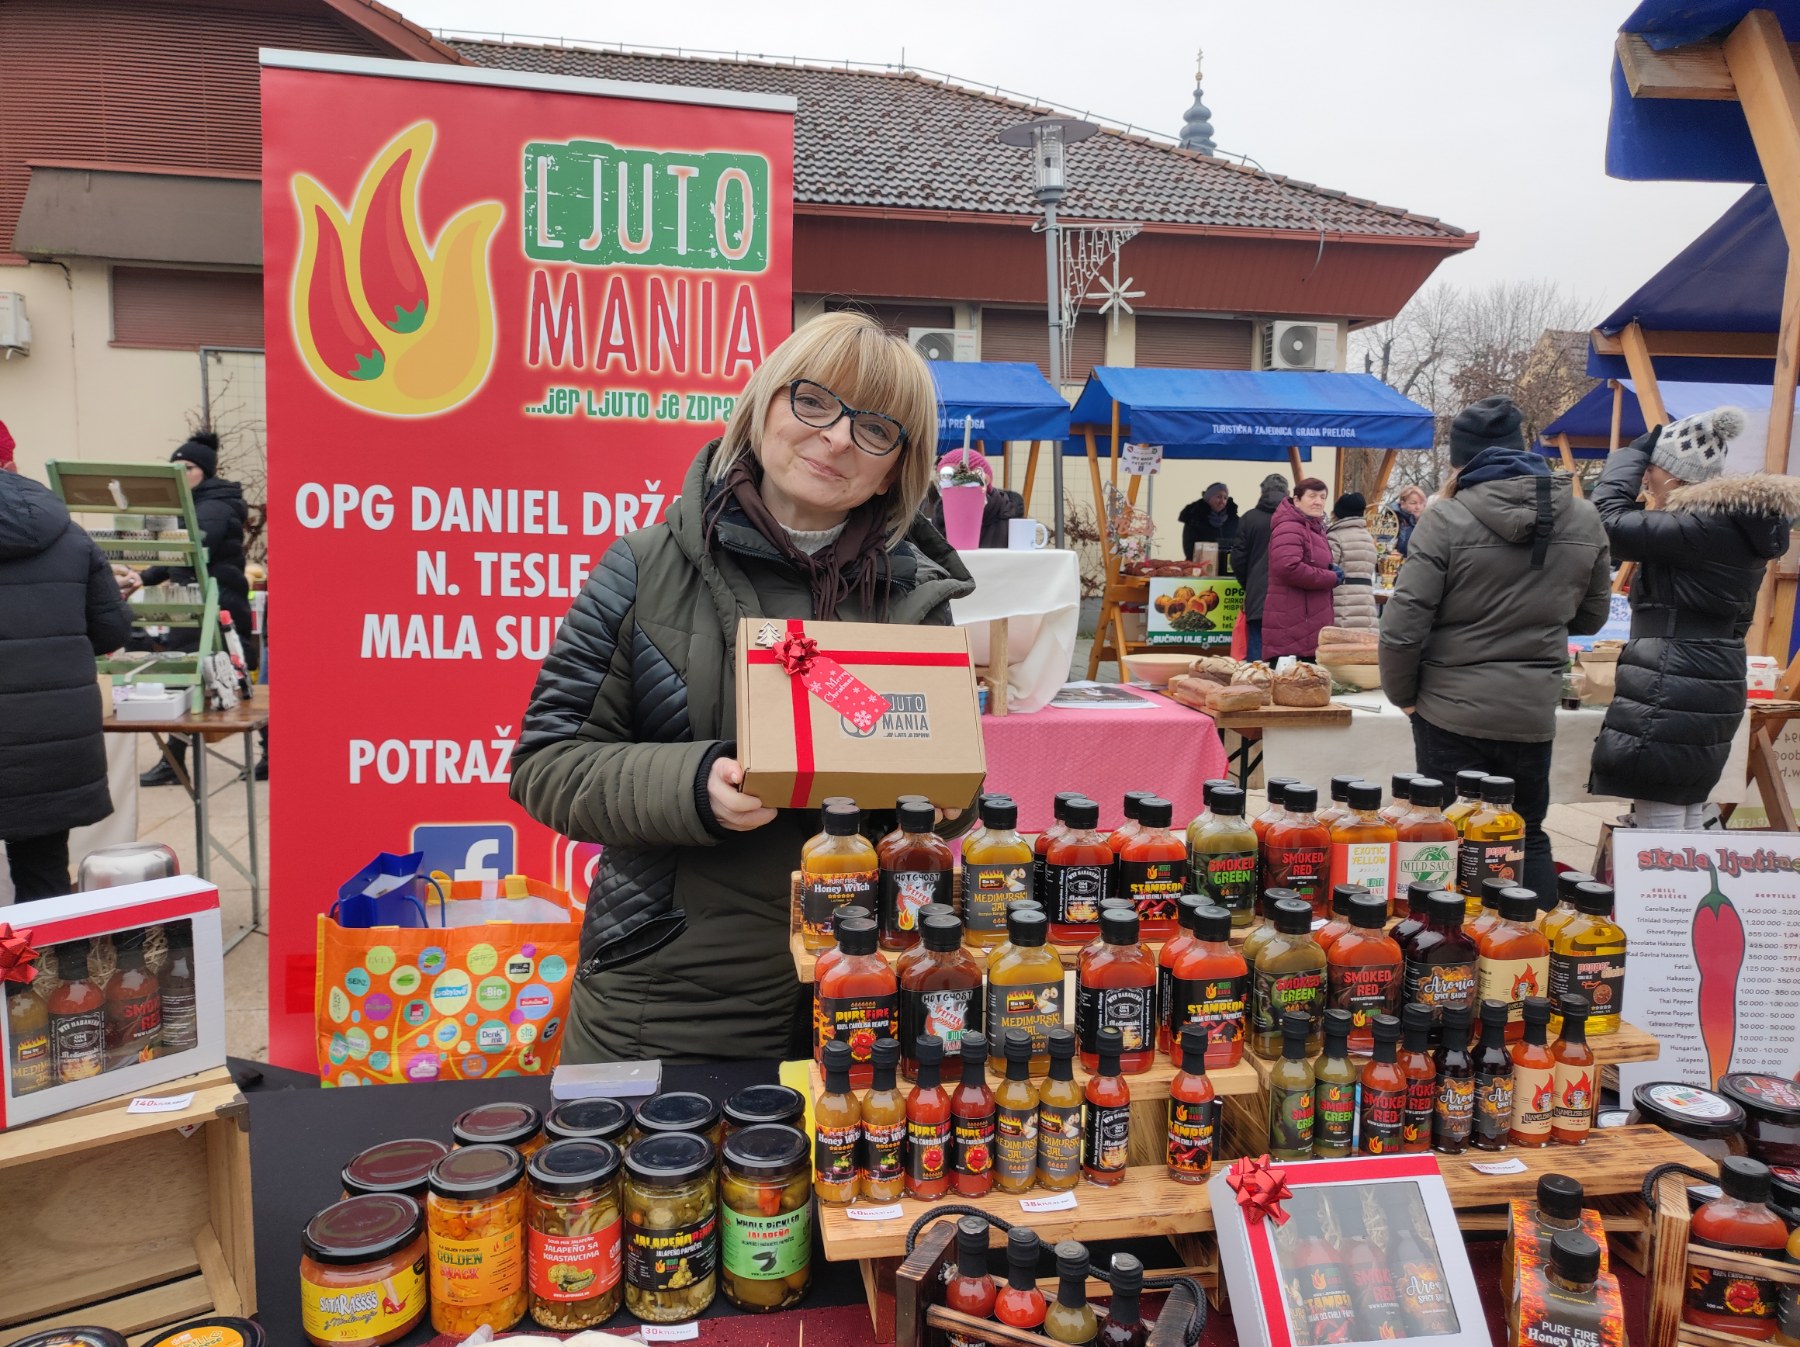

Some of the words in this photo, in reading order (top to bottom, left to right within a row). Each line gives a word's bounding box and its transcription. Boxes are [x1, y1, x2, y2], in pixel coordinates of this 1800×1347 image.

[536, 155, 753, 260] LJUTO
[528, 270, 764, 377] MANIA
[948, 418, 985, 430] PREOGA
[1212, 424, 1252, 435] TURISTIČKA
[1255, 426, 1292, 437] ZAJEDNICA
[1296, 427, 1321, 437] GRADA
[1322, 427, 1356, 438] PRELOGA
[295, 482, 394, 530] OPG
[411, 486, 568, 535] DANIEL
[583, 480, 682, 537] DRŽ
[416, 551, 459, 596] N.
[474, 552, 591, 598] TESLE
[361, 613, 482, 660] MALA
[496, 615, 564, 660] SU
[1153, 634, 1183, 643] BUČINO
[1183, 635, 1202, 643] ULJE
[825, 671, 850, 690] Merry
[891, 695, 924, 712] JUTO
[882, 713, 929, 731] MANIA
[350, 725, 518, 784] POTRAŽ
[1353, 846, 1386, 855] EXOTIC
[1208, 858, 1255, 872] SMOKED
[1282, 852, 1324, 864] SMOKED
[1352, 856, 1386, 865] YELLOW
[1292, 864, 1313, 876] RED
[1403, 861, 1428, 872] MILD
[1429, 860, 1456, 871] SAUCE
[1213, 870, 1251, 885] GREEN
[814, 882, 842, 894] Honey
[1275, 975, 1321, 992] SMOKED
[1343, 970, 1392, 983] SMOKED
[1356, 984, 1379, 997] RED
[1424, 976, 1476, 994] Aronia
[922, 993, 941, 1003] HOT
[1280, 988, 1316, 1003] GREEN
[482, 1031, 501, 1039] Denk
[1409, 1097, 1431, 1110] RED
[1373, 1110, 1398, 1123] RED
[818, 1133, 843, 1146] Honey
[865, 1130, 889, 1144] Honey
[544, 1243, 585, 1254] JALAPEÑO
[587, 1241, 599, 1251] SA
[633, 1231, 692, 1250] JALAPEÑO
[437, 1250, 482, 1266] GOLDEN
[543, 1250, 600, 1262] KRASTAVCIMA
[1527, 1327, 1568, 1347] Honey
[1541, 1321, 1572, 1337] PURE
[1573, 1328, 1598, 1343] FIRE
